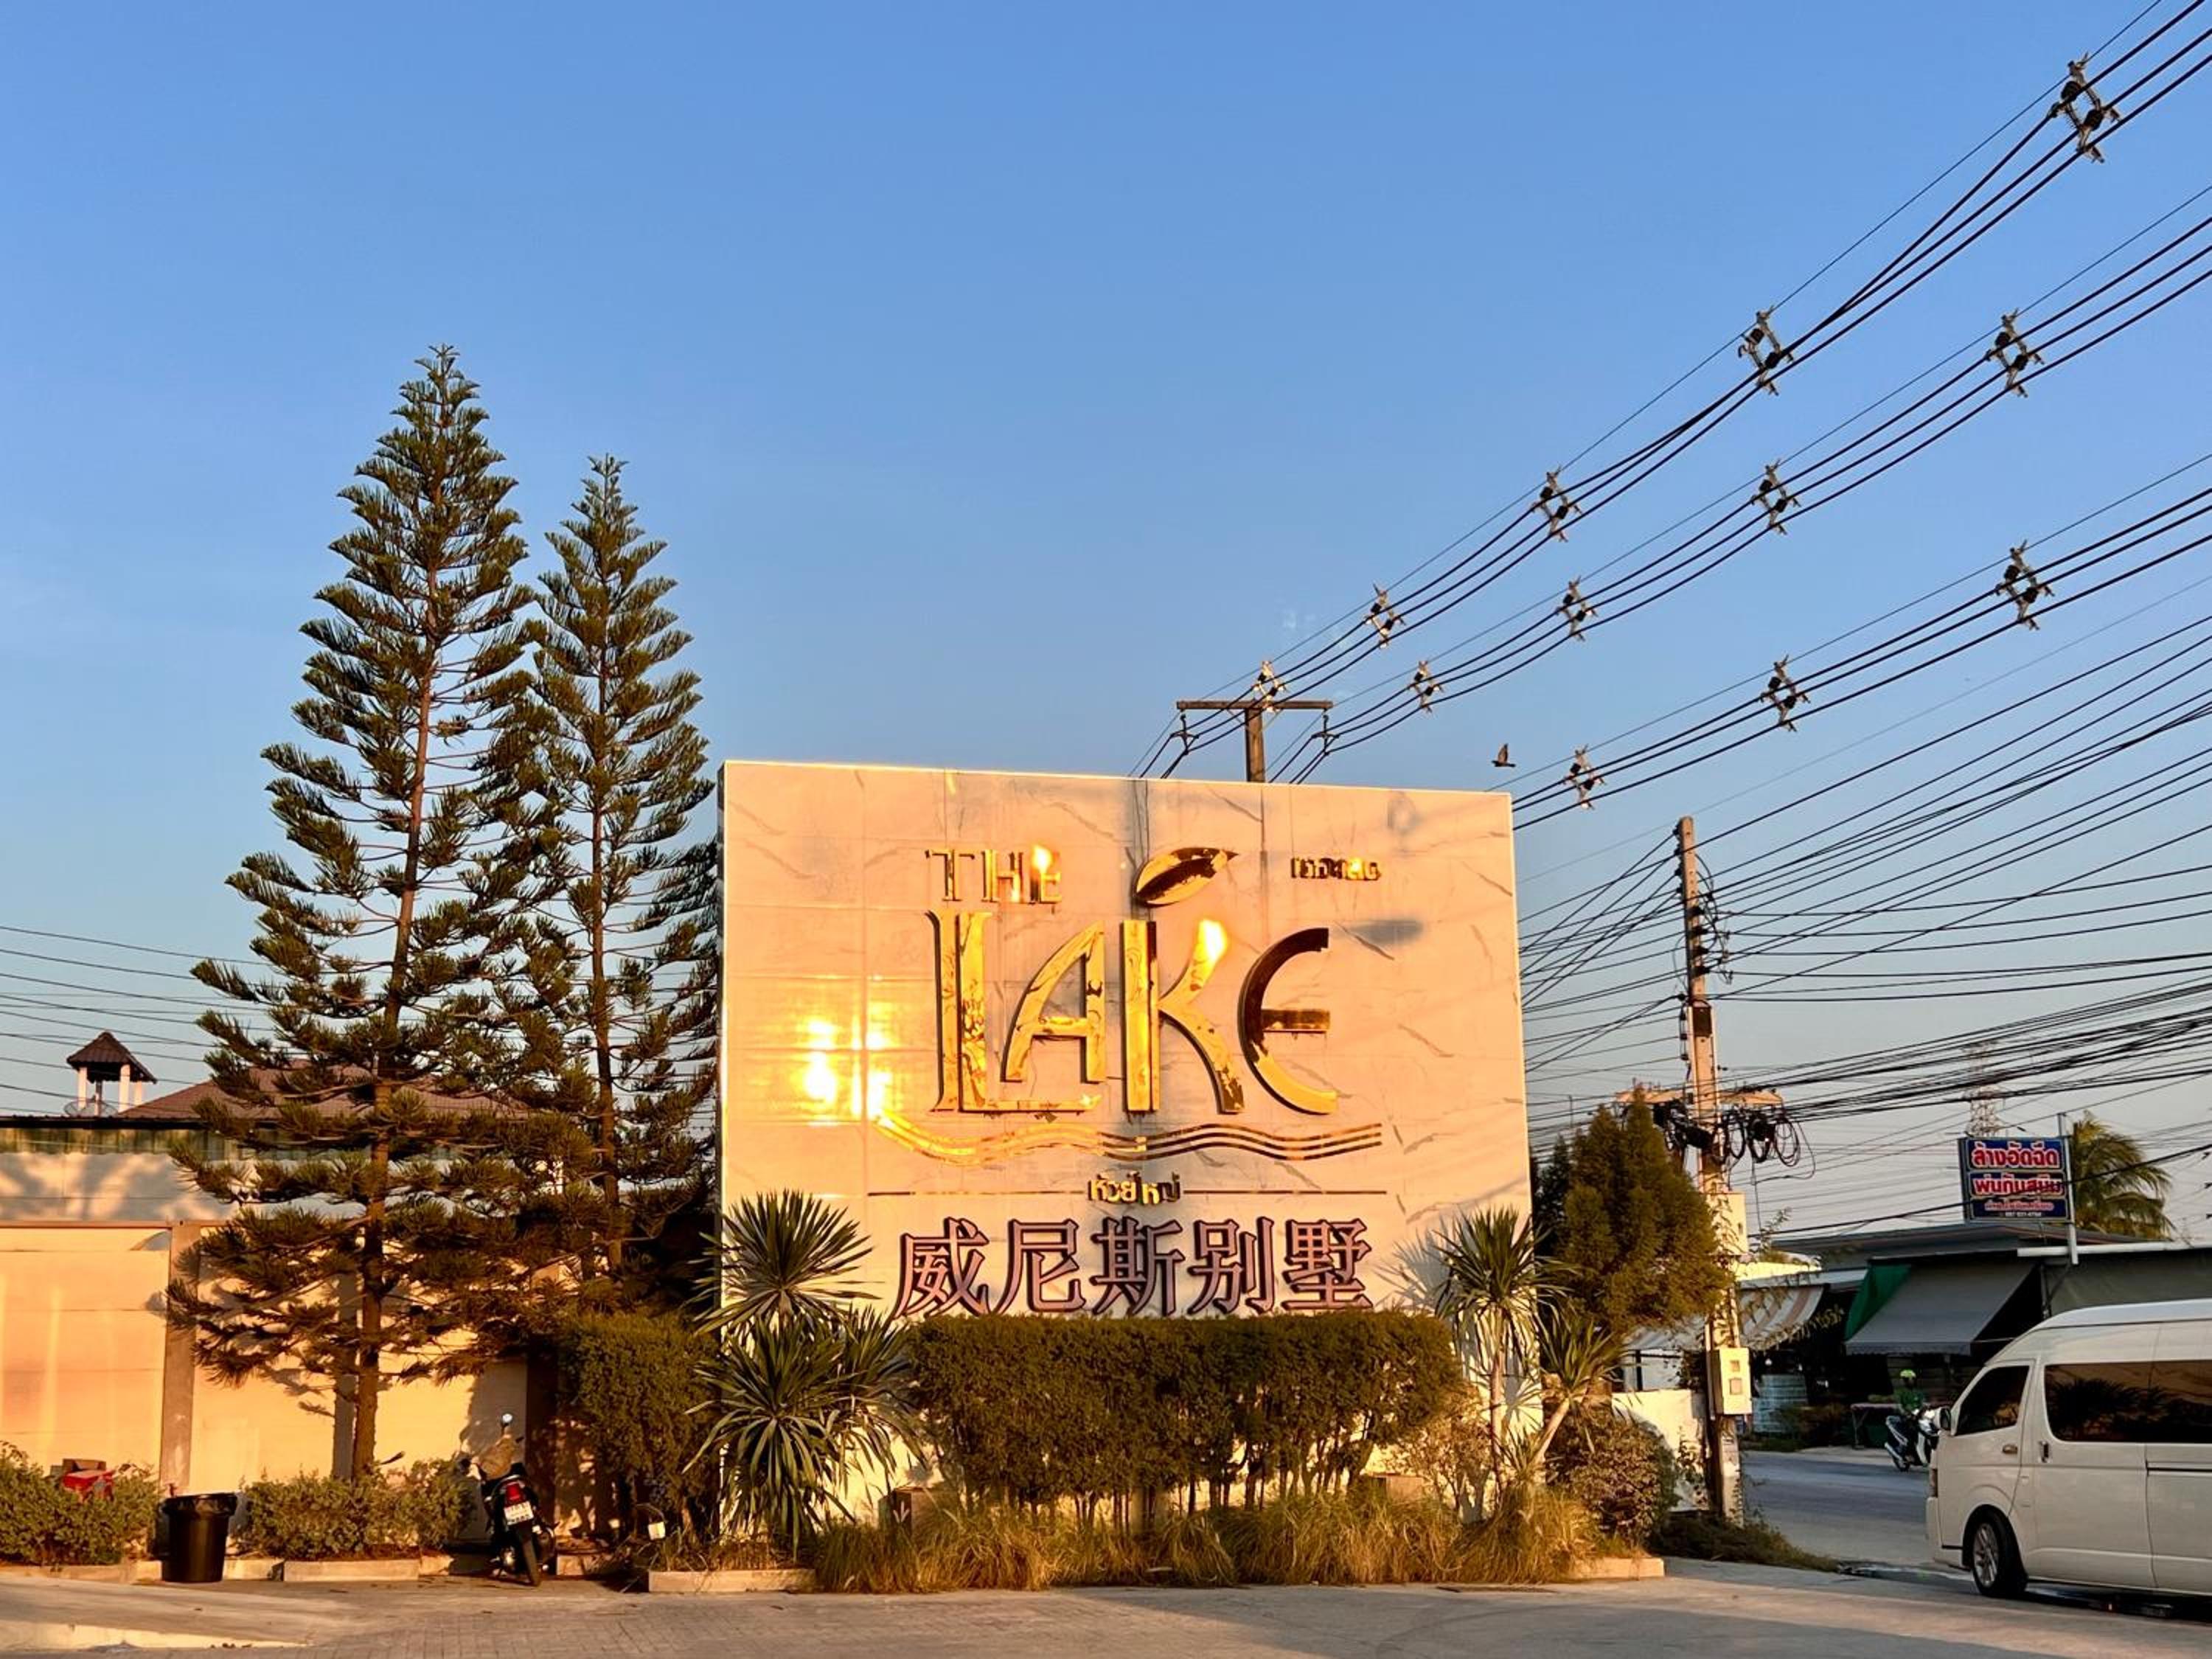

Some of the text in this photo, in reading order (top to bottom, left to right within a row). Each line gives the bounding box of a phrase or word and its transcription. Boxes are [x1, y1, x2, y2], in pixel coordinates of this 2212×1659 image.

[925, 849, 1062, 903] THE
[926, 911, 1339, 1115] LAKE
[1972, 1141, 2060, 1168] ล้างอัดฉีด
[1088, 1170, 1180, 1206] ห้วยใหญ่
[887, 1216, 1374, 1318] 威尼斯别墅
